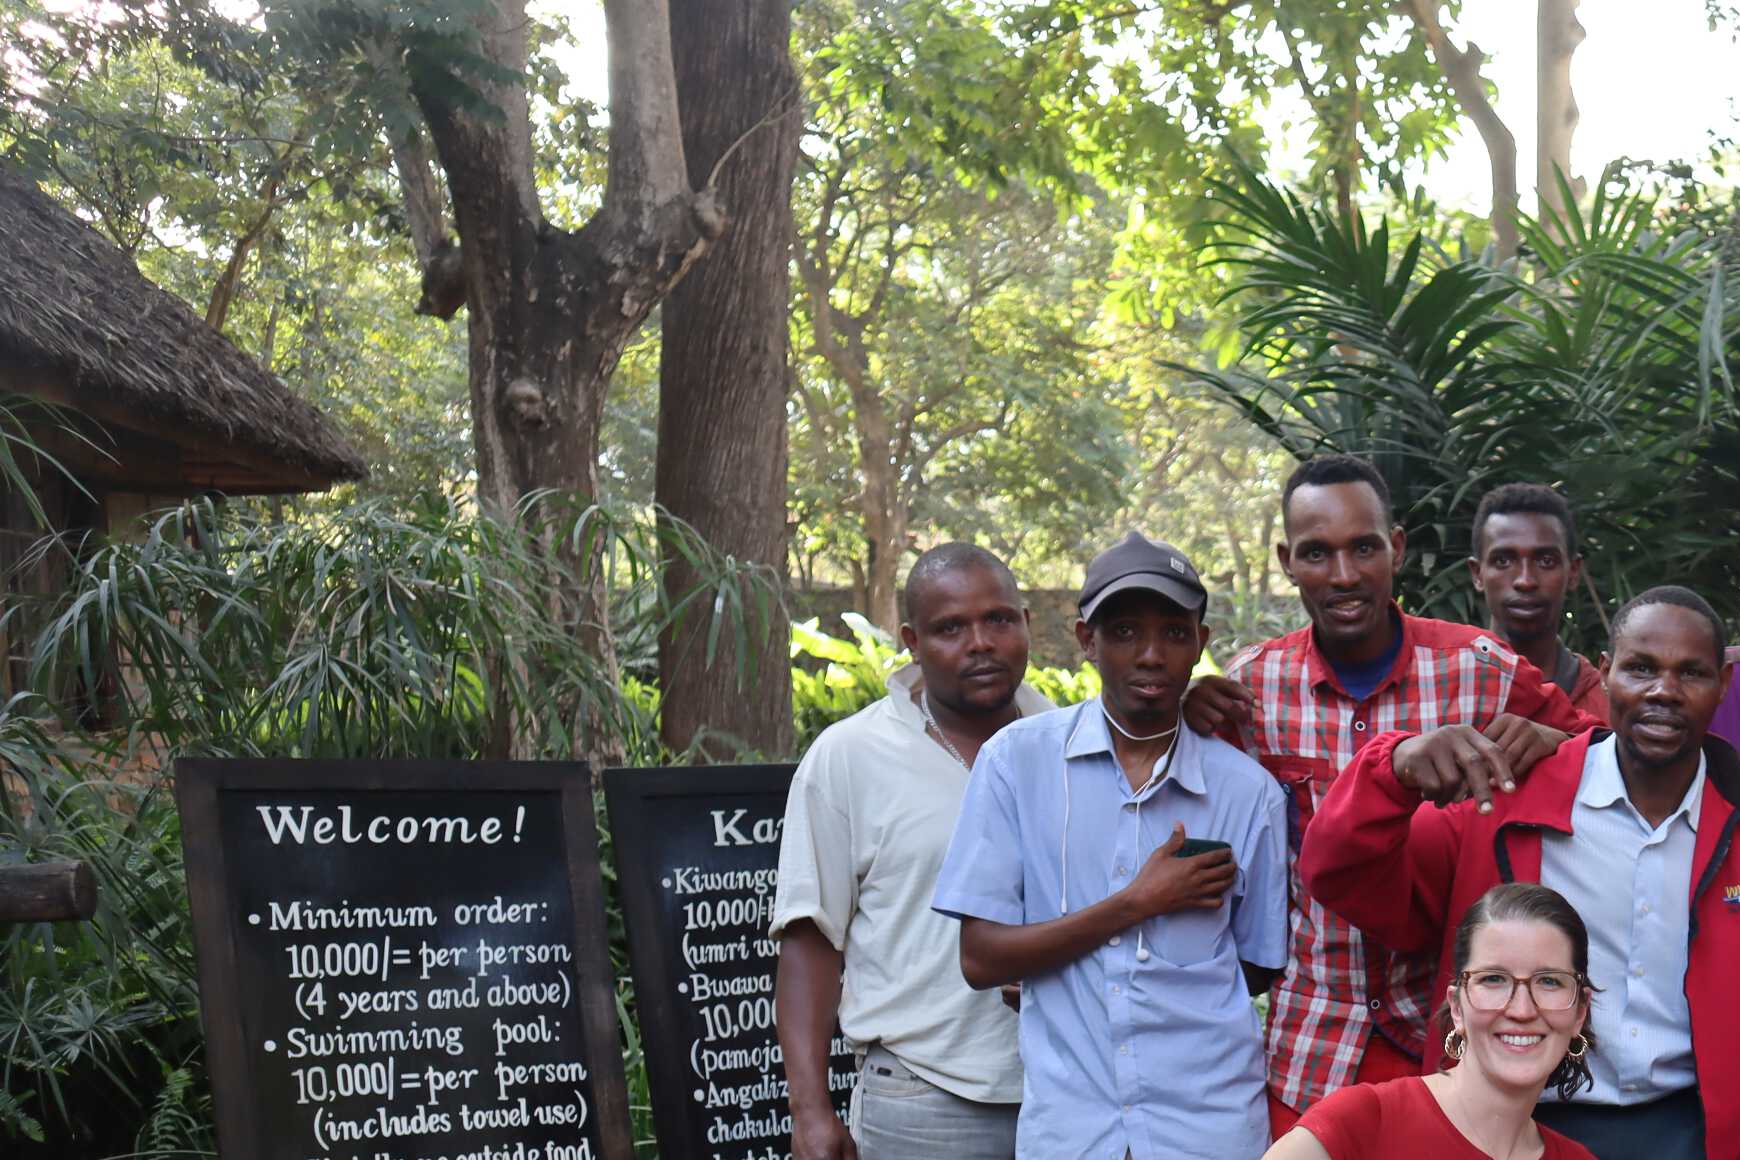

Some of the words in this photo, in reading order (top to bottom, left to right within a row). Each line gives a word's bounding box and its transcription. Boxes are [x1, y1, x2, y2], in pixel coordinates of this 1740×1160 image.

[256, 805, 527, 845] Welcome!
[270, 902, 437, 931] Minimum
[454, 896, 548, 925] order:
[285, 936, 411, 982] 10,000/=
[419, 941, 467, 980] per
[477, 938, 572, 976] person
[682, 932, 750, 971] (umri
[294, 981, 327, 1021] (4
[339, 985, 418, 1020] years
[427, 977, 479, 1010] and
[487, 970, 572, 1009] above)
[690, 973, 772, 1002] Bwawa
[287, 1022, 464, 1059] Swimming
[493, 1016, 561, 1056] pool:
[700, 997, 776, 1042] 10,00
[292, 1057, 421, 1104] 10,000/=
[424, 1064, 478, 1105] per
[496, 1058, 587, 1100] person
[705, 1076, 789, 1110] Angaliz
[313, 1106, 452, 1151] (includes
[460, 1097, 529, 1130] towel
[534, 1090, 588, 1129] use)
